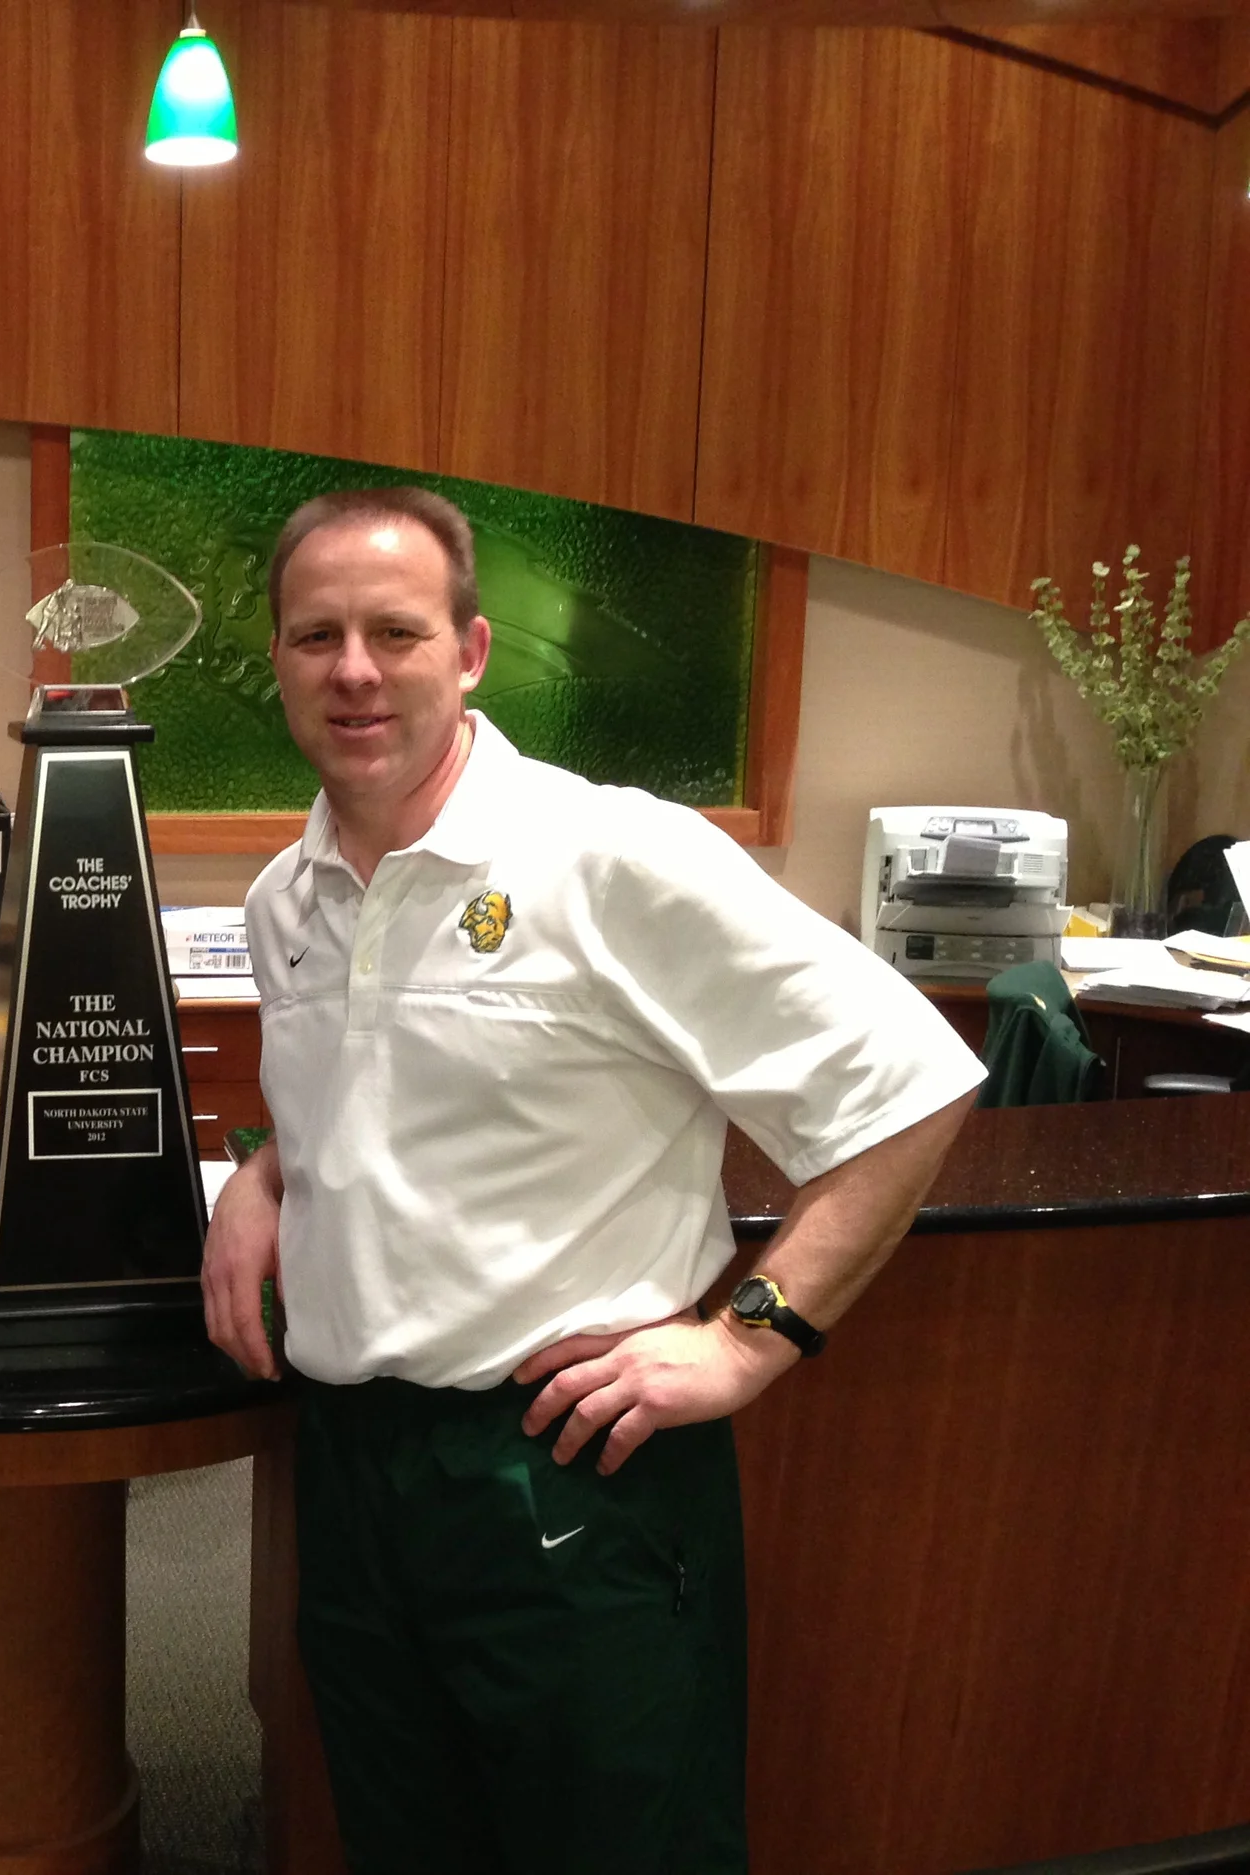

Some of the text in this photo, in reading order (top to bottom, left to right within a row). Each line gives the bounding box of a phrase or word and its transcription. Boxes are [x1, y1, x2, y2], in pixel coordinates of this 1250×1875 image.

[76, 857, 104, 873] THE
[49, 875, 132, 892] COACHES'
[60, 893, 122, 910] TROPHY
[193, 932, 235, 943] METEOR
[69, 994, 116, 1013] THE
[36, 1018, 151, 1039] NATIONAL
[32, 1043, 155, 1065] CHAMPION
[79, 1069, 110, 1083] FCS
[43, 1106, 149, 1118] NORTH DAKOTA STATE
[67, 1119, 124, 1130] UNIVERSITY
[87, 1132, 106, 1142] 2012
